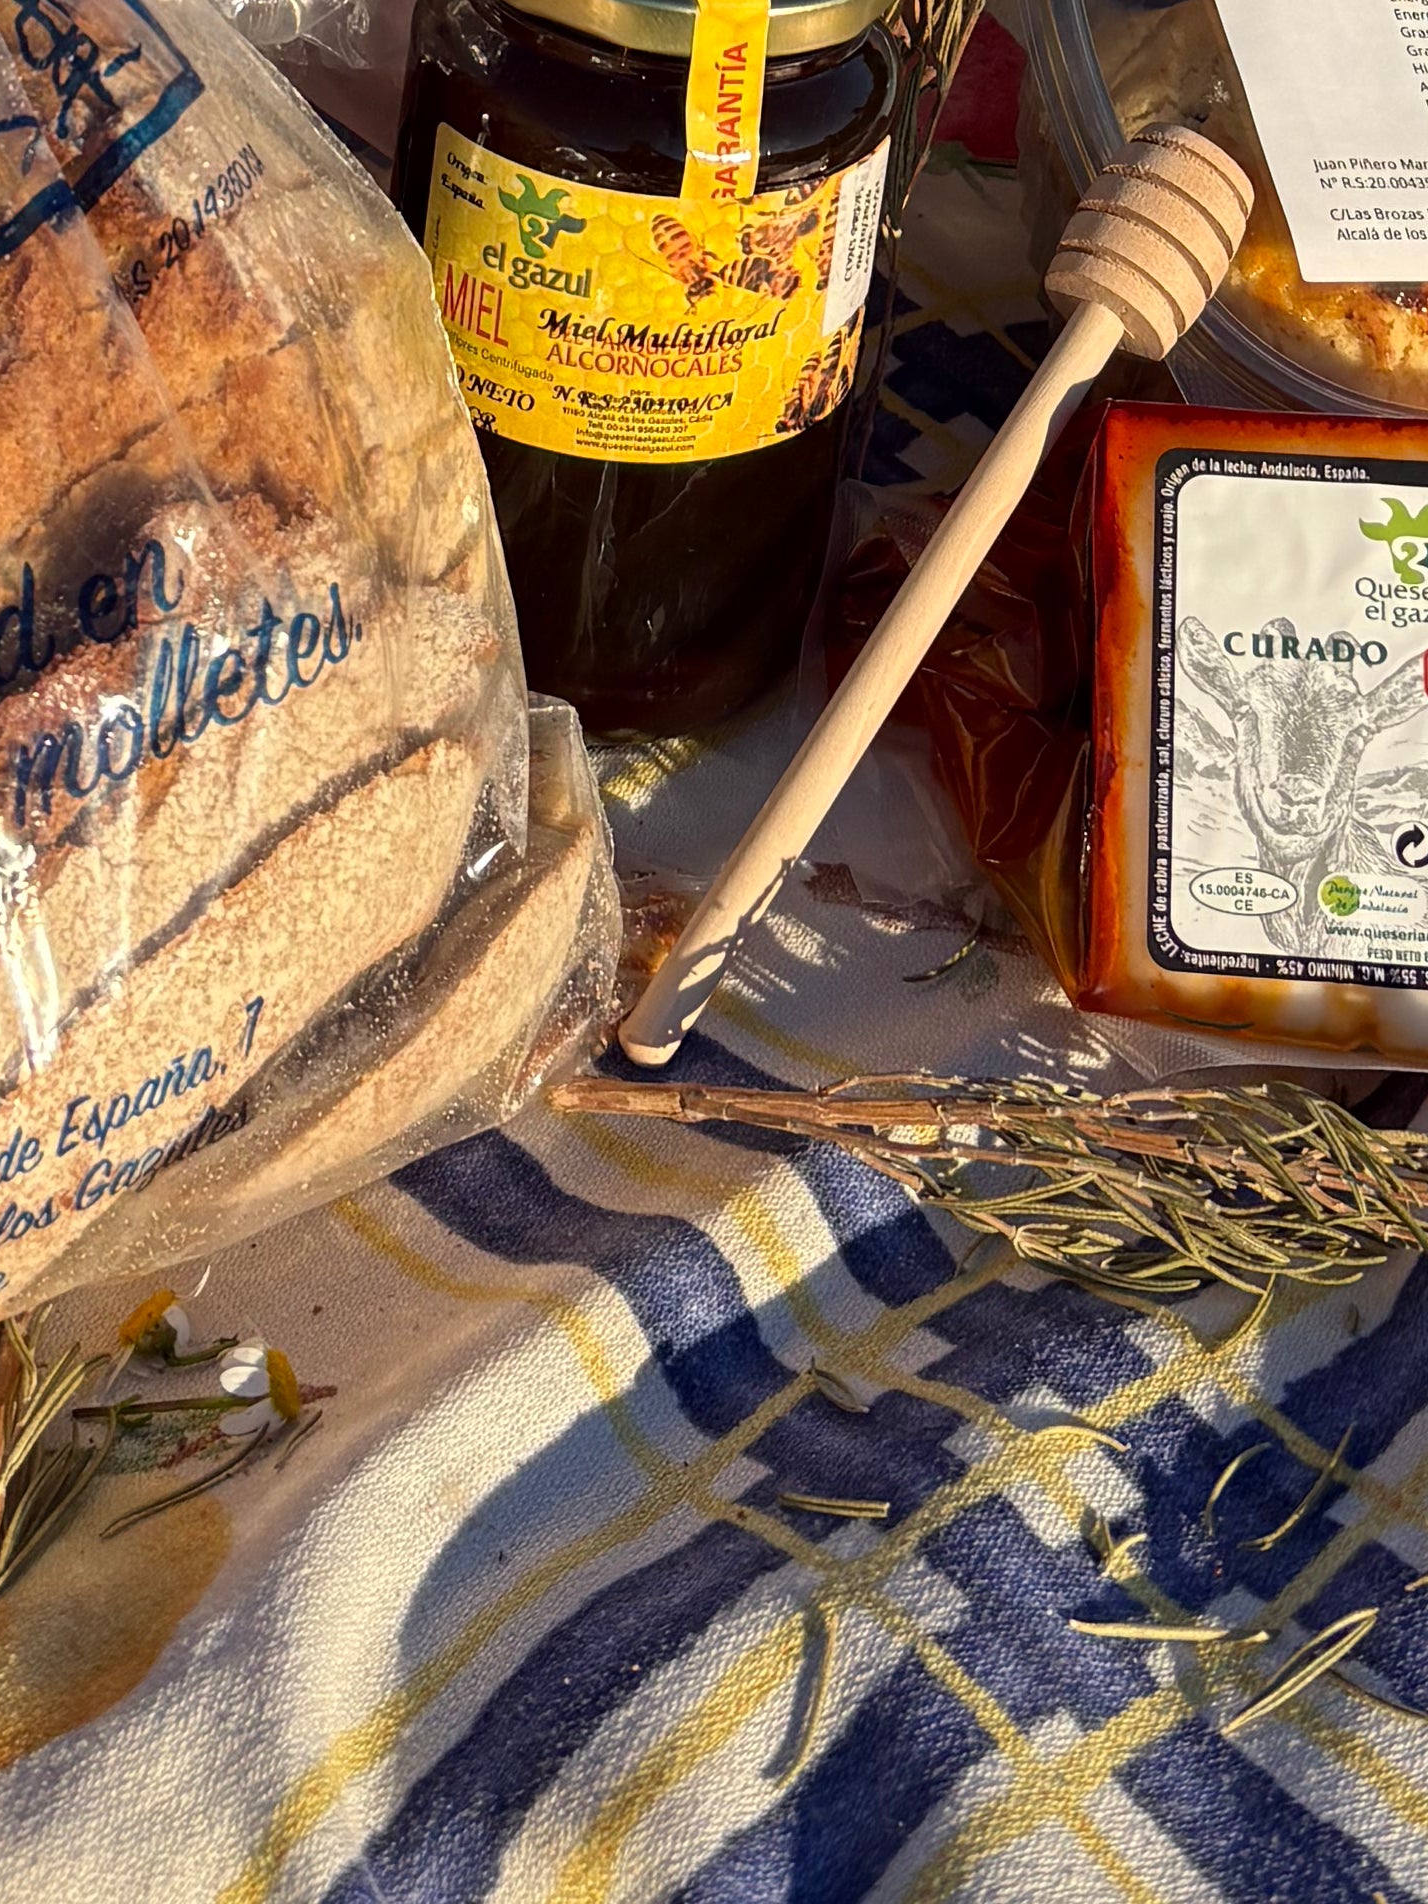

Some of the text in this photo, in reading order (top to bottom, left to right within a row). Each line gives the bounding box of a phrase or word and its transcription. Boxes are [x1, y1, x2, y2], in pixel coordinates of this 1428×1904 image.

[1313, 158, 1347, 173] Juan
[1350, 158, 1397, 171] Piñero
[1330, 208, 1372, 221] C/Las
[1374, 208, 1425, 221] Brozas
[1337, 227, 1381, 241] Alcalá
[1384, 228, 1402, 240] de
[1406, 228, 1427, 241] los
[482, 242, 506, 272] el
[508, 257, 592, 298] gazul
[443, 264, 509, 349] MIEL
[537, 308, 786, 356] Miel Multifloral
[481, 347, 555, 383] Centrifugada
[547, 343, 743, 379] ALCORNOCALES
[466, 373, 536, 412] NETO
[1161, 463, 1190, 496] Origen
[1192, 458, 1206, 472] de
[1209, 458, 1220, 472] la
[1224, 459, 1258, 474] leche:
[1325, 465, 1370, 481] España.
[1159, 545, 1173, 590] lácticos
[79, 538, 185, 644] en
[1158, 594, 1172, 650] fermentos
[1365, 602, 1386, 621] el
[1224, 632, 1388, 667] CURADO
[14, 582, 363, 828] molletes.
[1156, 698, 1171, 740] cloruro
[1157, 743, 1172, 766] sal,
[1156, 768, 1172, 851] pasteurizada,
[1155, 858, 1168, 885] cabra
[1235, 872, 1253, 884] ES
[1153, 896, 1167, 911] de
[1234, 899, 1253, 911] CE
[1153, 915, 1179, 958] LECHE
[1180, 951, 1260, 974] Ingredientes:
[1277, 959, 1304, 976] 45%
[1308, 961, 1354, 983] MÍNIMO
[1390, 967, 1417, 985] 55%
[56, 1045, 229, 1158] España,
[74, 1099, 249, 1212] Gazules
